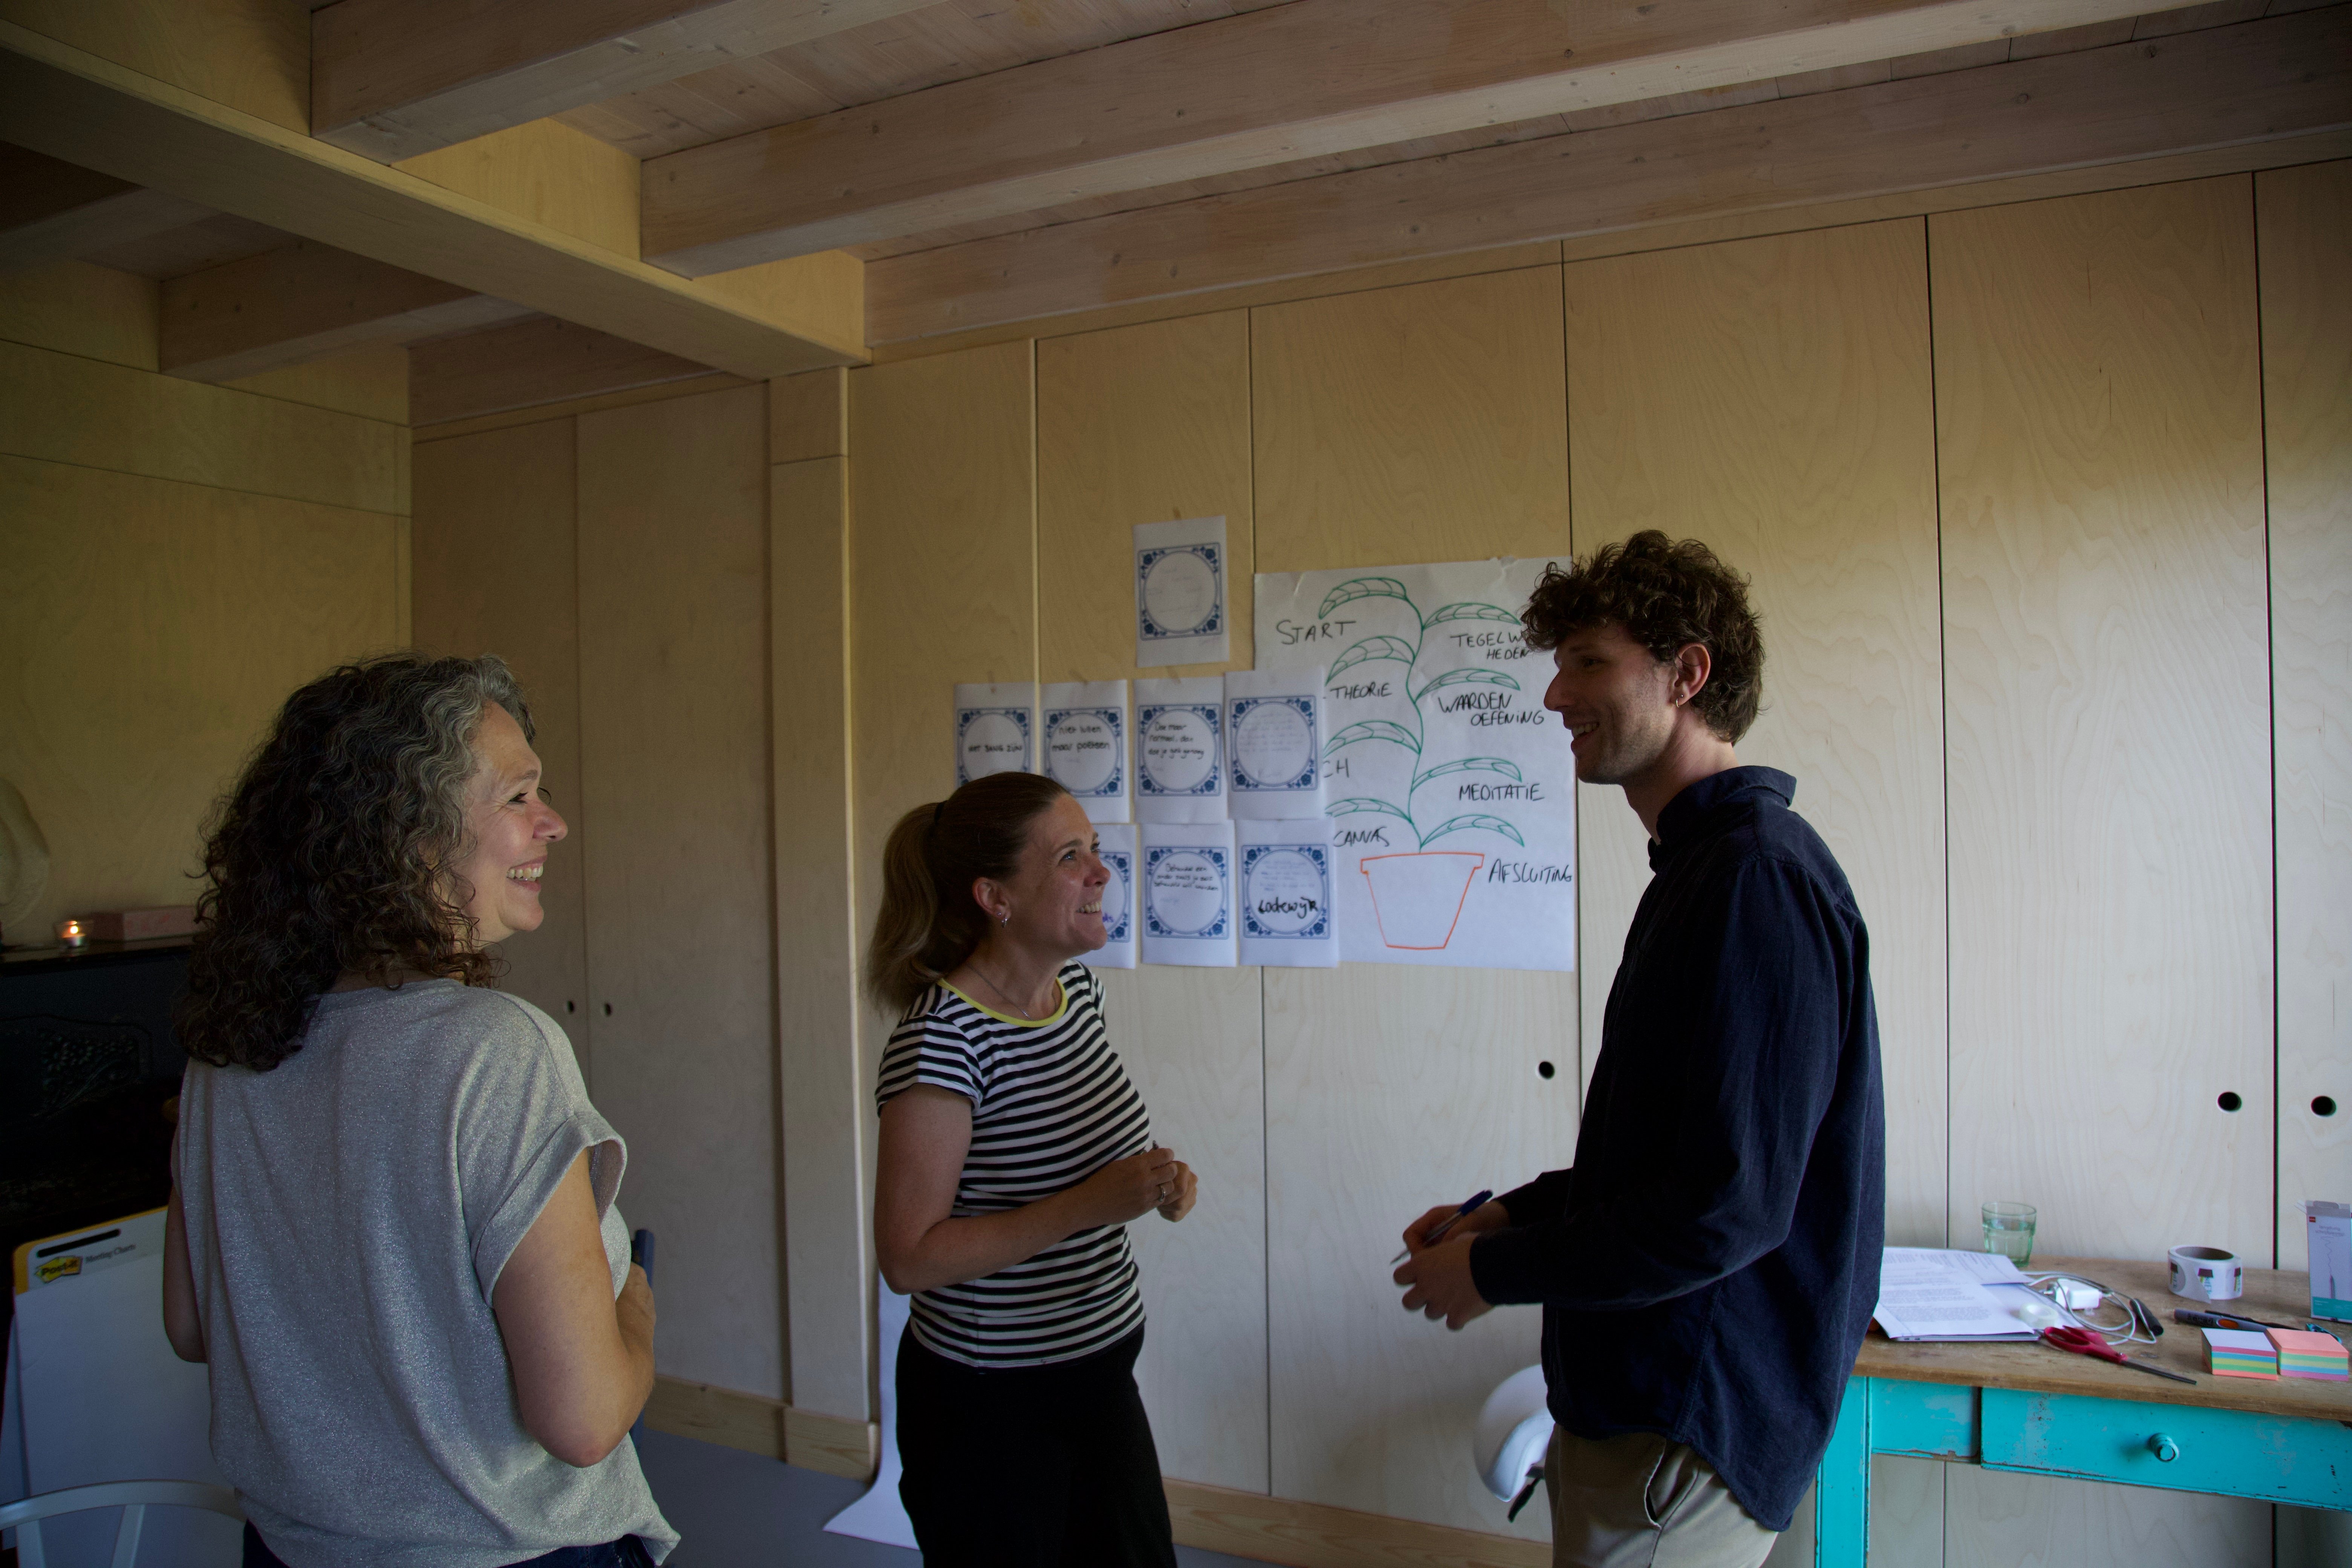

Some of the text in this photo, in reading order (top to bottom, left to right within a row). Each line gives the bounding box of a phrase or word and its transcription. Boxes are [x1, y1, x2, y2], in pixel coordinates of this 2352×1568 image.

[1276, 619, 1357, 645] START
[1450, 631, 1523, 647] TEGELW
[1486, 647, 1530, 660] HEDEN
[1330, 681, 1392, 700] THEORIE
[1438, 692, 1512, 713] WAARDEN
[1471, 710, 1545, 726] OEFENING
[1323, 758, 1350, 778] CH
[1459, 783, 1545, 802] MEDITATIE
[1333, 826, 1390, 847] CANVAS
[1488, 858, 1573, 884] AFSLUITING
[41, 1259, 79, 1276] Post-it
